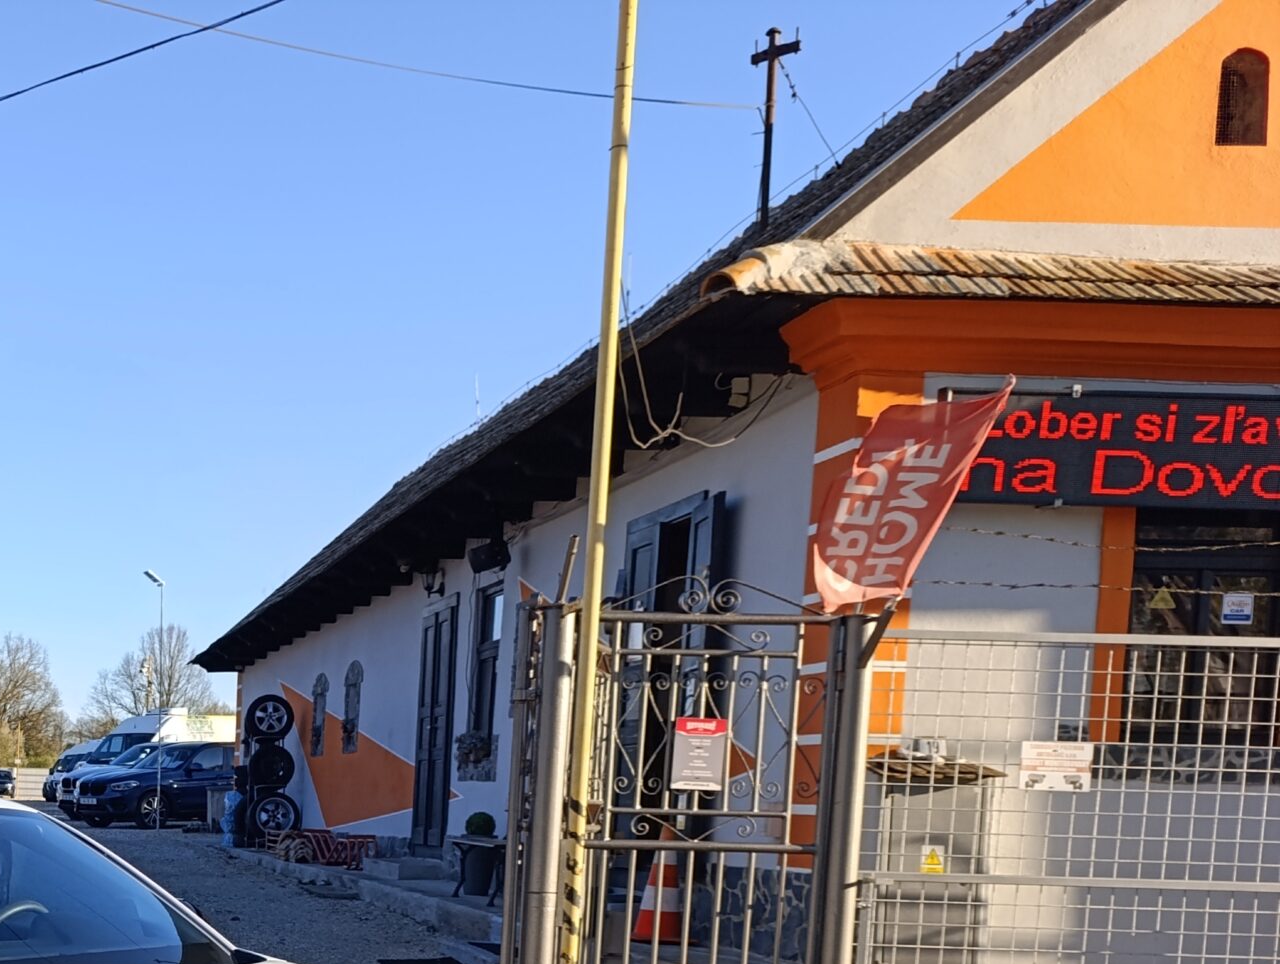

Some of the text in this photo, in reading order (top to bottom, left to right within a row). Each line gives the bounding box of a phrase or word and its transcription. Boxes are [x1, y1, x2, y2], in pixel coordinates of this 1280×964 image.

[1135, 404, 1179, 442] si
[1192, 405, 1280, 445] zľa
[960, 456, 1057, 493] na
